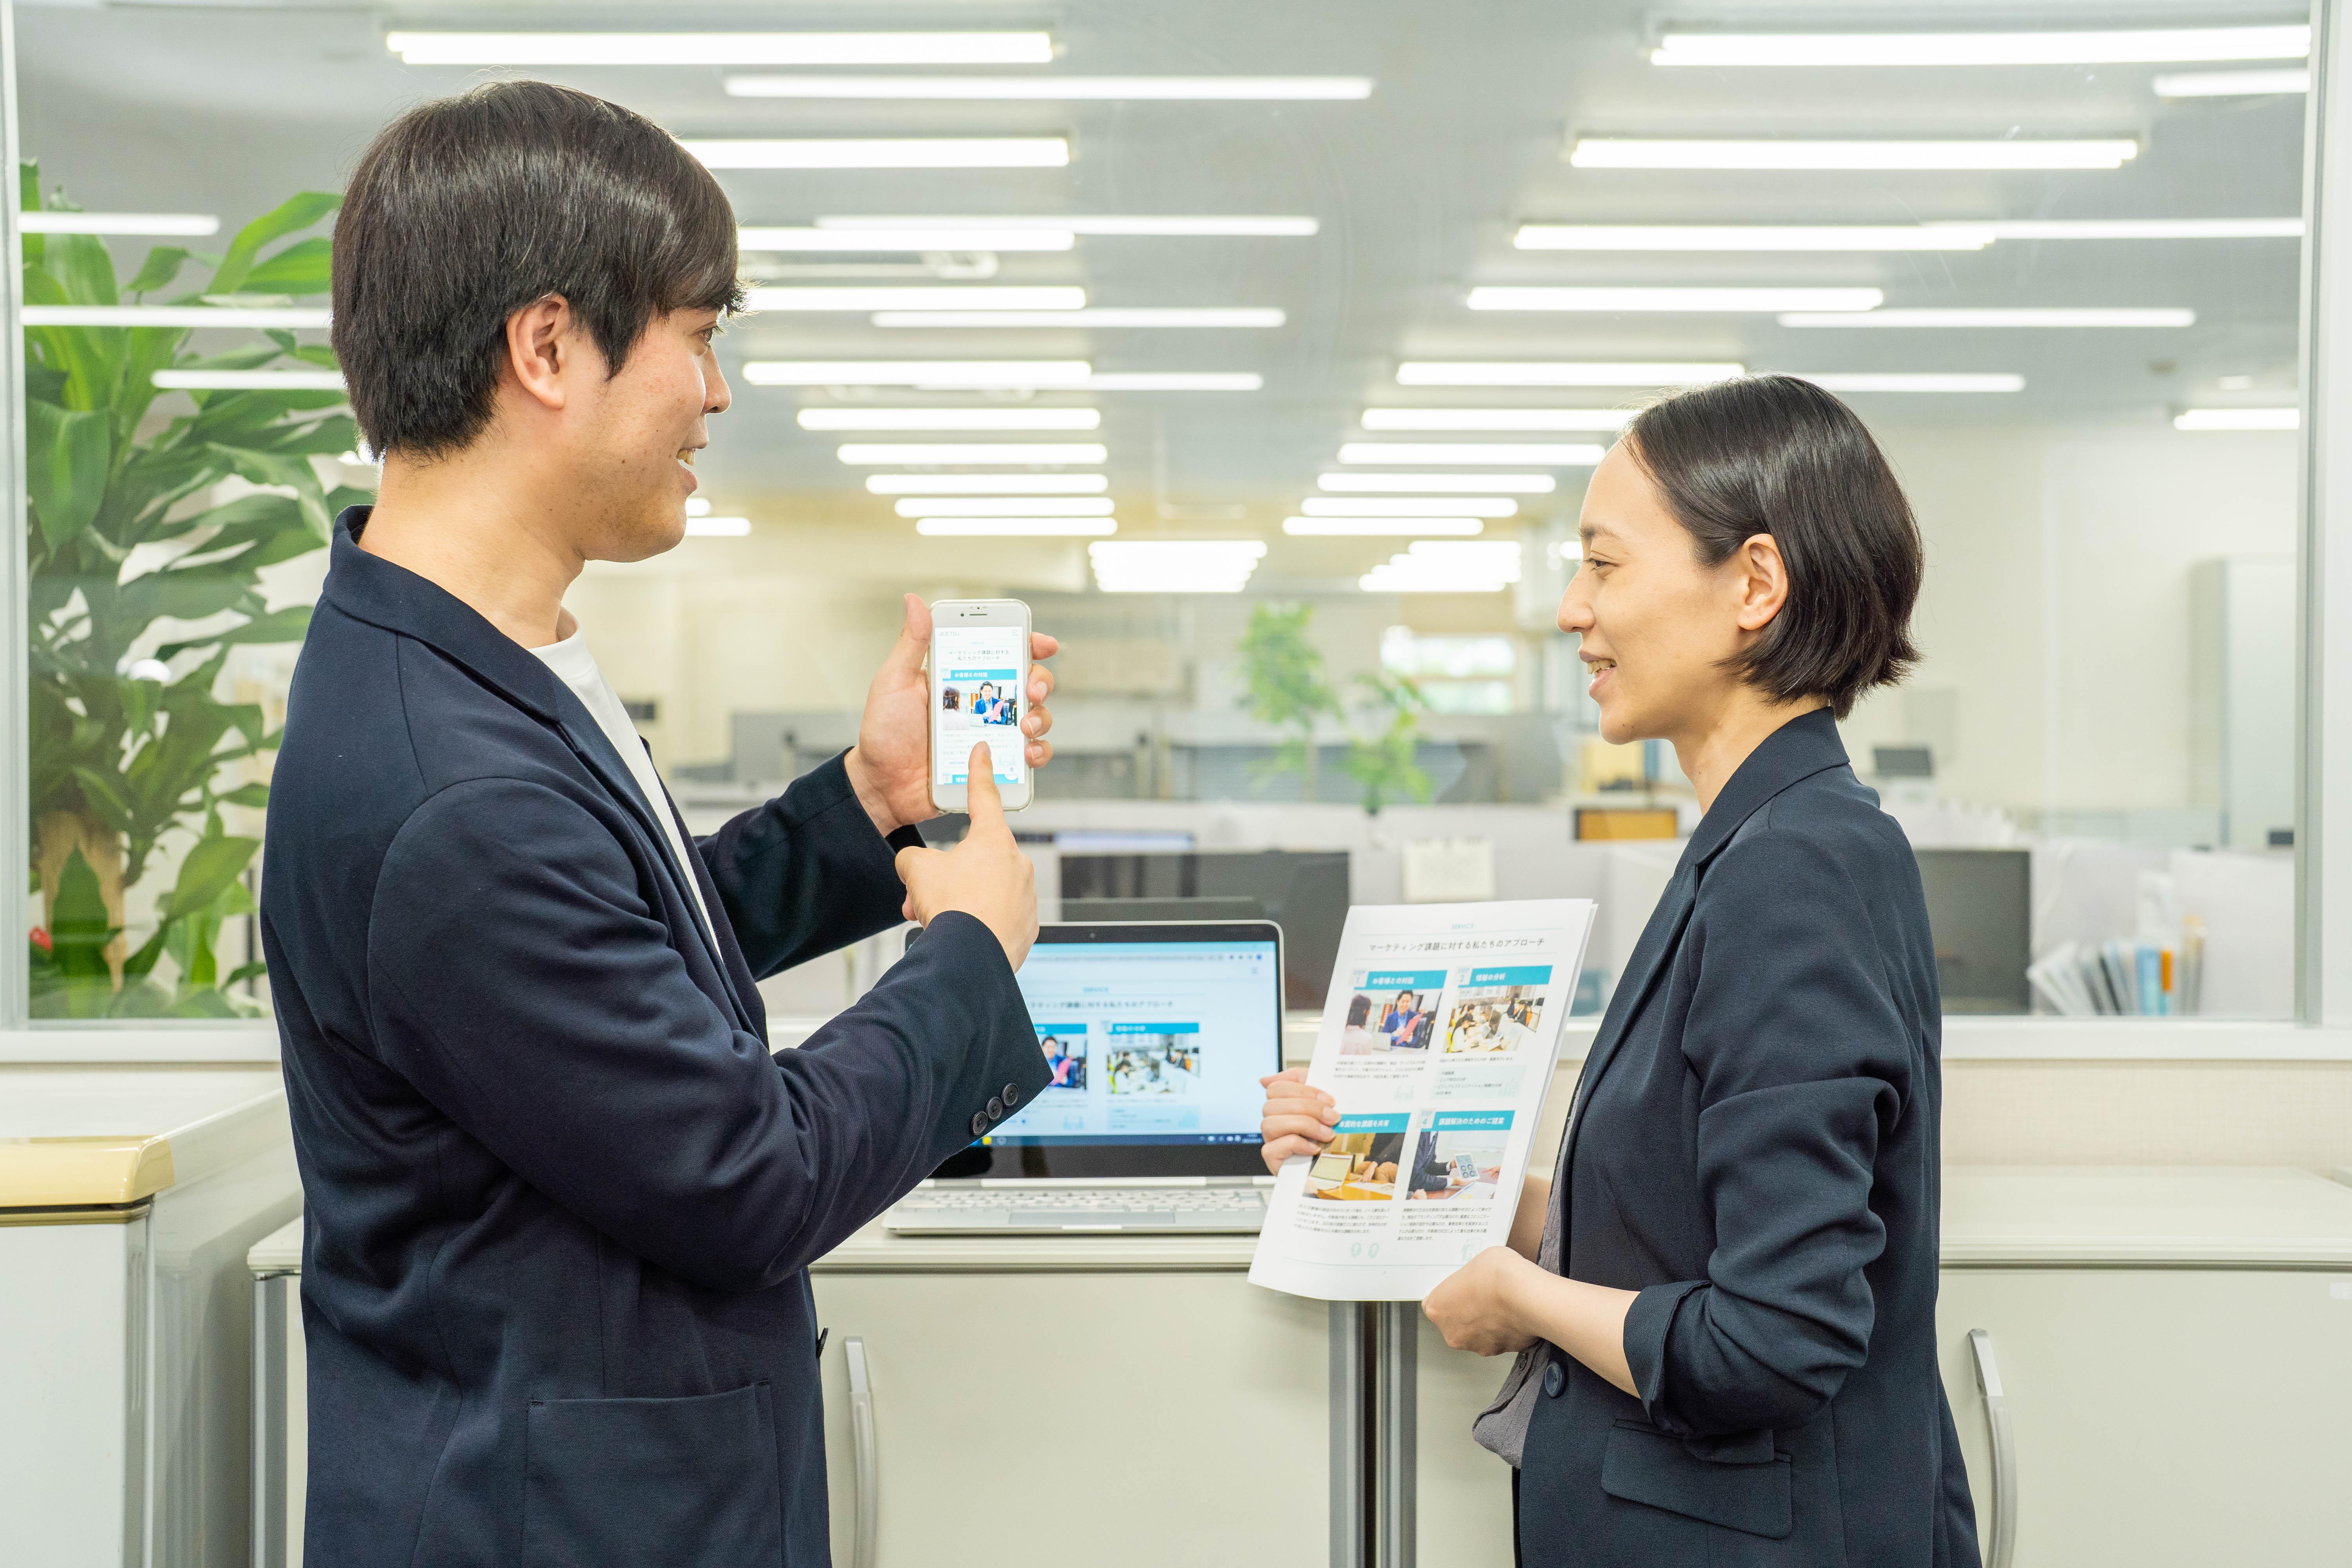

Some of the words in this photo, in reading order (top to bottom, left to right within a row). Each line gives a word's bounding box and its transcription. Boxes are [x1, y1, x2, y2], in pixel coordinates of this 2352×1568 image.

[1369, 938, 1545, 951] マーケティング課題に対する私たちのアプローチ
[1372, 976, 1415, 985] お客様との対話
[1459, 974, 1465, 983] 2
[1475, 973, 1506, 982] 情報の分析
[1437, 1117, 1505, 1126] 課題解決のためのご提案
